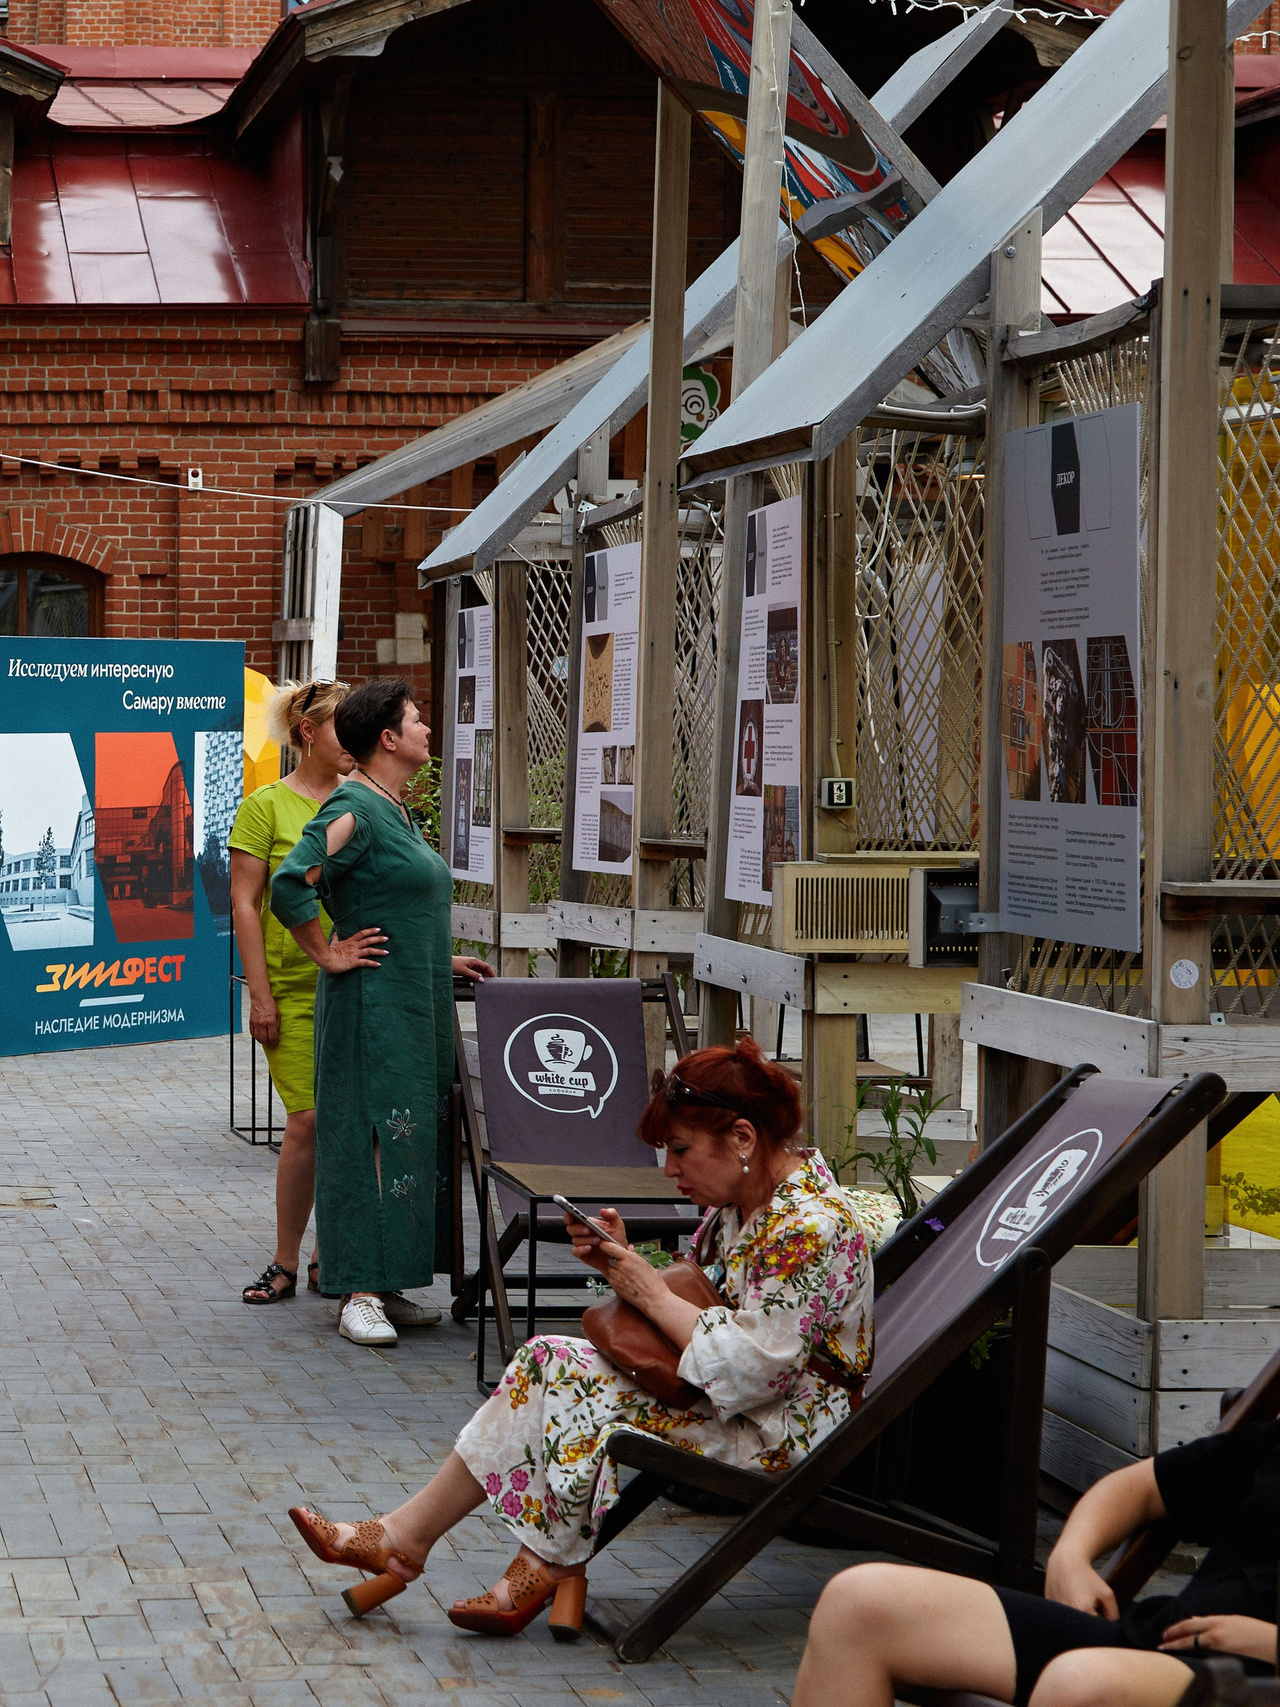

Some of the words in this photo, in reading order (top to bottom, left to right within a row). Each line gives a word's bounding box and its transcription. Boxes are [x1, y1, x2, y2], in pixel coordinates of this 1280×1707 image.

[8, 659, 89, 682] Исследуем
[91, 663, 174, 683] интересную
[122, 690, 175, 715] Самару
[176, 694, 226, 710] вместе
[35, 1015, 100, 1035] НАСЛЕДИЕ
[103, 1008, 185, 1029] МОДЕРНИЗМА
[535, 1073, 566, 1085] white
[569, 1076, 588, 1087] cup
